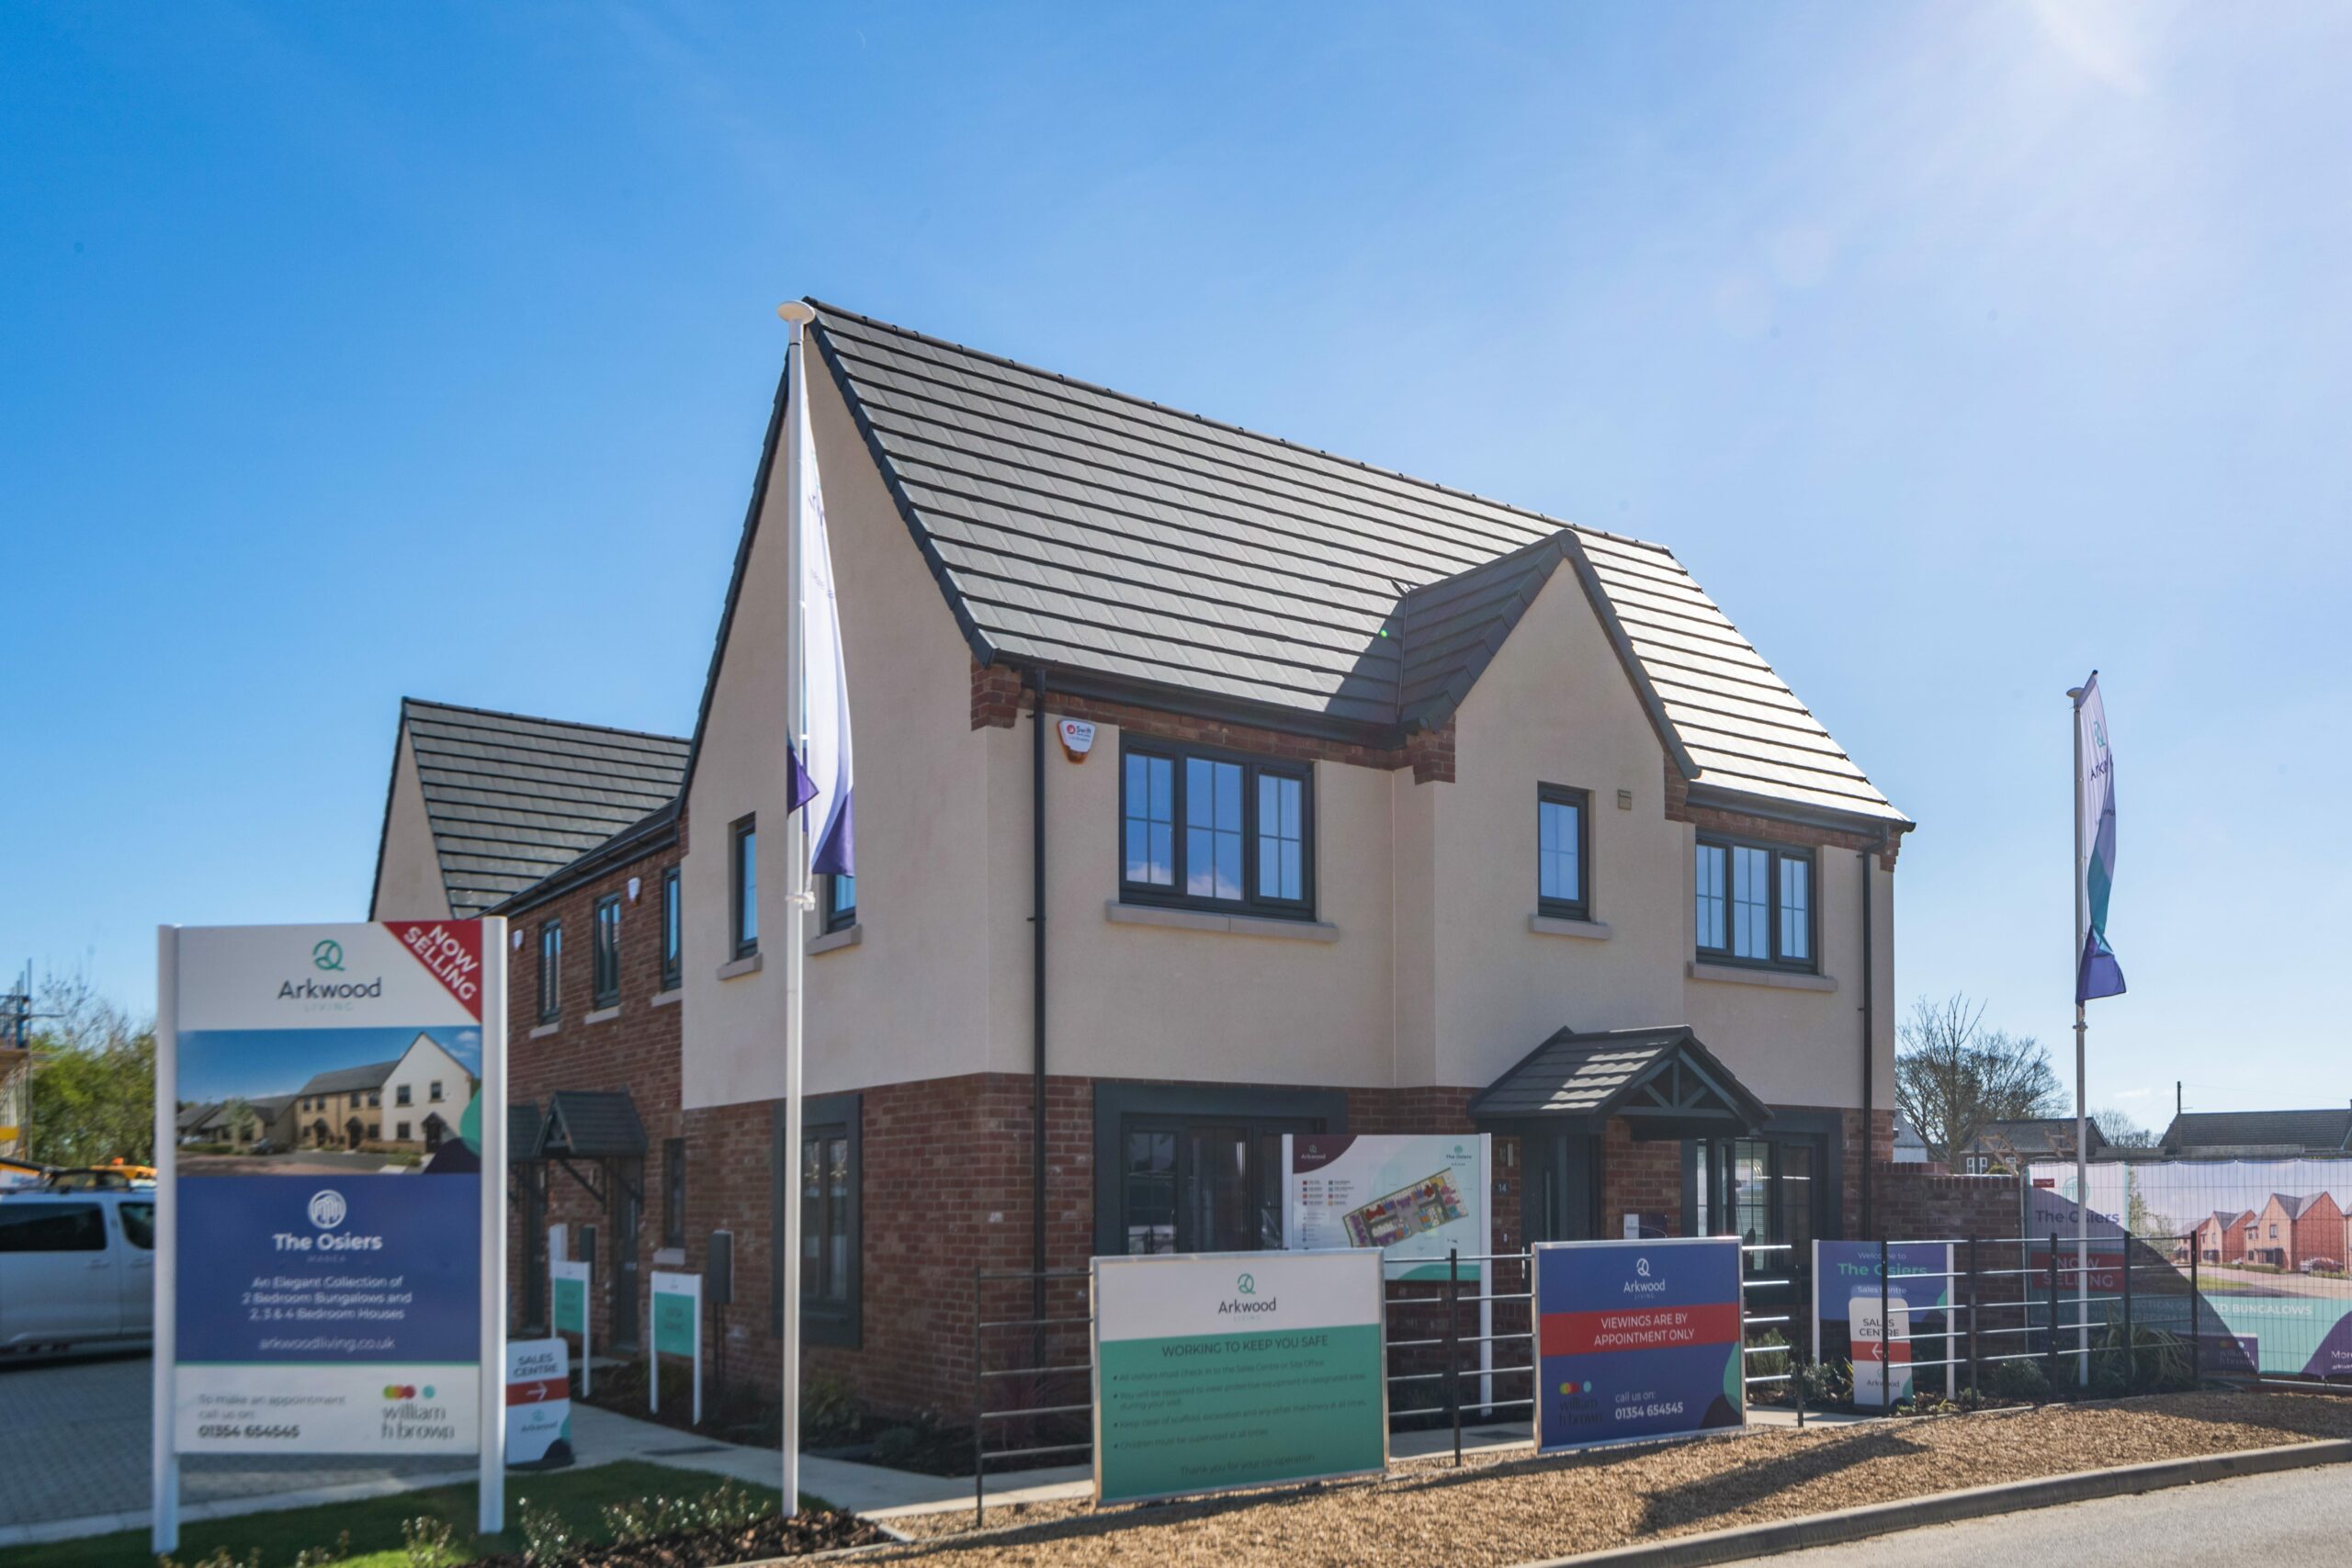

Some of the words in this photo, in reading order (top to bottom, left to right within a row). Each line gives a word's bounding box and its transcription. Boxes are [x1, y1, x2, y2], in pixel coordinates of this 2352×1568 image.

[428, 923, 479, 973] NOW
[403, 926, 477, 1000] SELLING
[277, 976, 381, 999] Arkwood
[1498, 1182, 1507, 1193] 14
[2036, 1210, 2064, 1223] The
[273, 1233, 312, 1250] The
[317, 1232, 383, 1250] Osiers
[2057, 1256, 2100, 1268] NOW
[1838, 1263, 1869, 1276] The
[252, 1276, 271, 1288] An
[273, 1276, 322, 1291] Elegant
[324, 1275, 387, 1288] Collection
[389, 1275, 404, 1287] of
[1623, 1279, 1666, 1293] Arkwood
[2042, 1273, 2113, 1287] SELLNG
[242, 1292, 251, 1305] 2
[253, 1292, 312, 1304] Bedroom
[313, 1292, 385, 1307] Bungalows
[387, 1292, 413, 1304] and
[1218, 1297, 1276, 1314] Arkwood
[296, 1307, 356, 1320] Bedroom
[357, 1307, 405, 1320] Houses
[2233, 1303, 2312, 1314] BUNGALOWS
[1601, 1314, 1651, 1329] VIEWINGS
[1654, 1314, 1673, 1325] ARE
[1676, 1313, 1688, 1325] BY
[1863, 1318, 1894, 1327] SALS
[1594, 1330, 1668, 1347] APPOINTMENT
[1668, 1328, 1695, 1341] ONLY
[1860, 1328, 1899, 1337] CENRE
[259, 1336, 396, 1353] arkwoodliving.co.uk
[1161, 1342, 1222, 1358] WORKING
[1225, 1341, 1240, 1353] TO
[1243, 1339, 1272, 1352] KEEP
[1275, 1337, 1299, 1349] YOU
[1301, 1335, 1328, 1348] SAFE
[517, 1352, 555, 1366] SALES
[513, 1363, 559, 1376] CENTRE
[1182, 1367, 1204, 1377] check
[1223, 1365, 1234, 1373] the
[1867, 1380, 1900, 1388] Arkwod
[198, 1393, 214, 1404] To
[216, 1394, 249, 1404] make
[251, 1395, 267, 1404] an
[269, 1394, 345, 1407] appointment
[1559, 1396, 1598, 1411] william
[1615, 1391, 1629, 1403] call
[1632, 1392, 1642, 1401] us
[1643, 1391, 1656, 1400] on:
[198, 1409, 220, 1420] call
[381, 1404, 447, 1421] william
[1615, 1405, 1645, 1420] 01354
[1646, 1402, 1683, 1416] 654545
[1569, 1412, 1602, 1426] brown
[198, 1425, 242, 1438] 01354
[243, 1424, 301, 1439] 654545
[381, 1423, 393, 1440] h
[396, 1423, 455, 1440] brown
[1180, 1462, 1207, 1477] Thank
